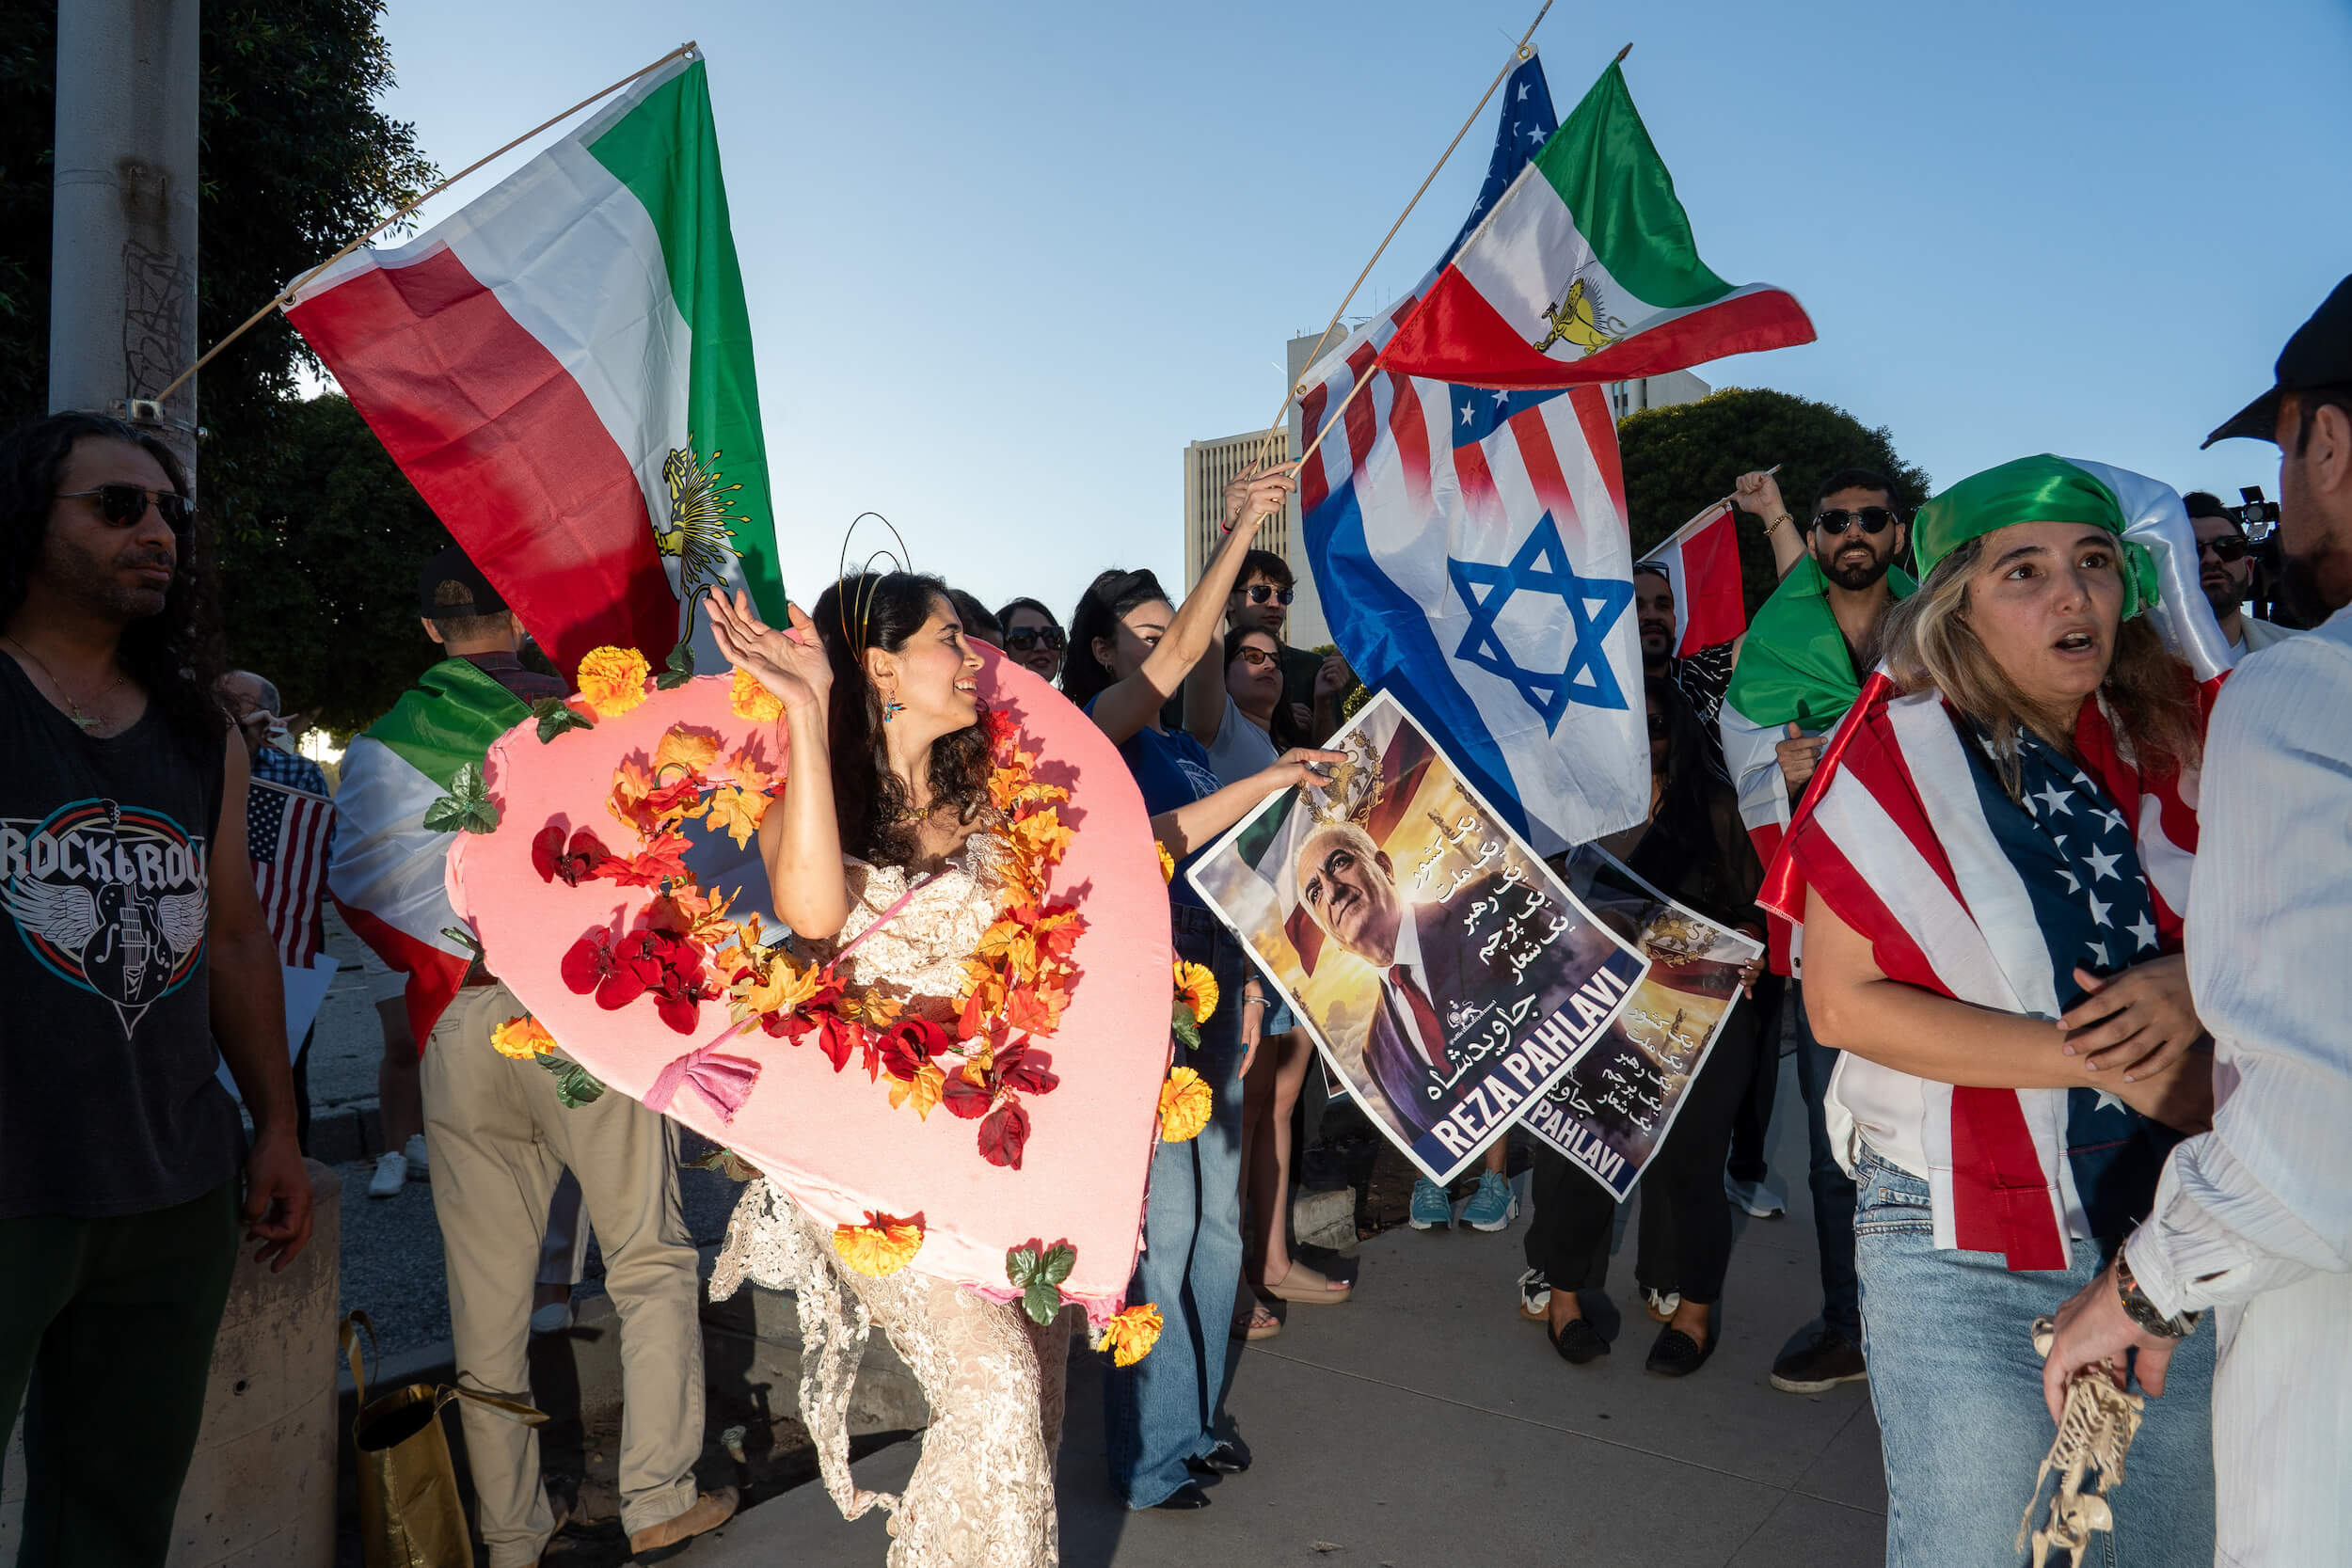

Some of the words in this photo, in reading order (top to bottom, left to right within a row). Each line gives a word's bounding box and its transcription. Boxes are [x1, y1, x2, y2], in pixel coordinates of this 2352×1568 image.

[1450, 816, 1483, 845] یک
[1413, 836, 1445, 889] کشور
[1471, 841, 1505, 870] یک
[1437, 868, 1472, 903] ملت
[1493, 865, 1529, 895] یک
[1463, 895, 1500, 937] رهبر
[1517, 891, 1552, 920] یک
[1479, 916, 1525, 966] پرچم
[1540, 916, 1576, 945] یک
[1509, 942, 1542, 986] شعار
[1628, 1008, 1671, 1030] کشور
[1626, 1028, 1656, 1053] ملت
[1668, 1030, 1694, 1054] یک
[1430, 1074, 1524, 1159] REZA
[1502, 965, 1629, 1092] PAHLAVI
[1614, 1053, 1645, 1078] رهبر
[1658, 1051, 1683, 1075] یک
[1602, 1069, 1638, 1100] پرچم
[1647, 1070, 1673, 1096] یک
[1597, 1091, 1629, 1115] شعار
[1639, 1091, 1662, 1117] یک
[1629, 1111, 1653, 1136] یک
[1529, 1099, 1626, 1183] PAHLAVI
